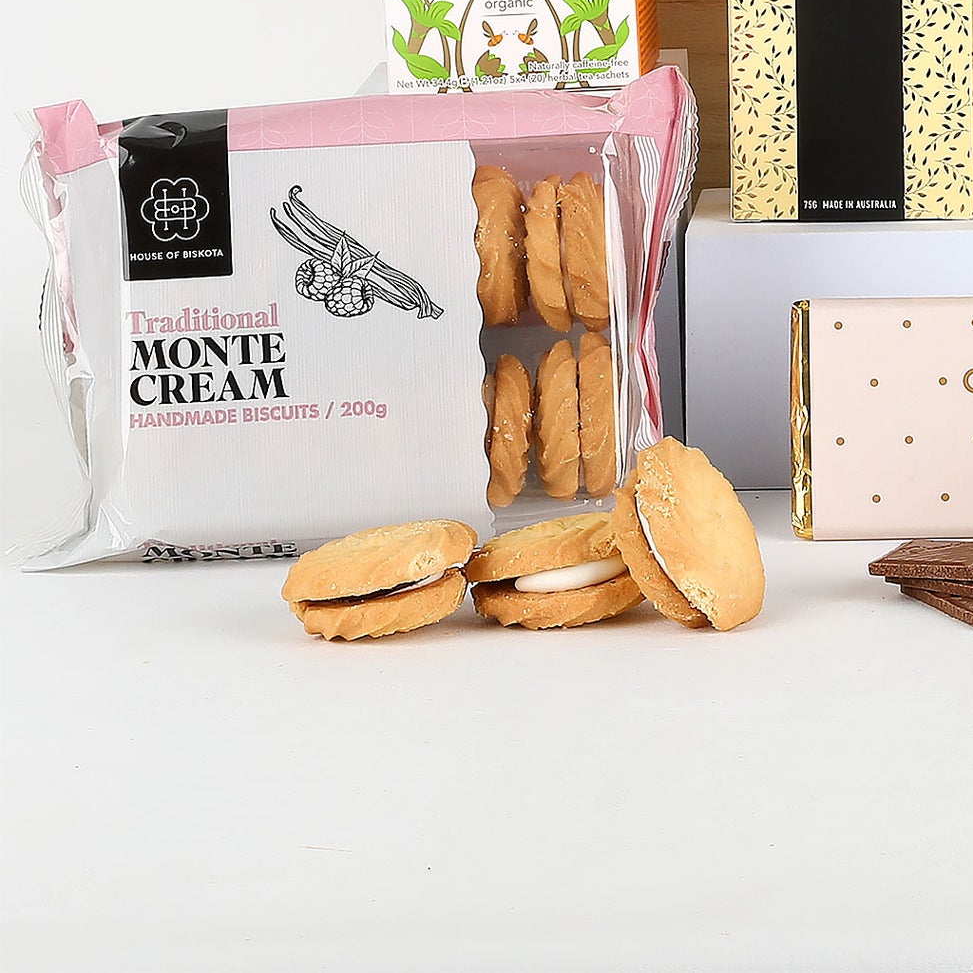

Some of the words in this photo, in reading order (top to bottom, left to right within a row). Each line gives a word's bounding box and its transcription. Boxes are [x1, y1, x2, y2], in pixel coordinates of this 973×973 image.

[529, 61, 570, 71] Naturally
[572, 58, 629, 68] caffeine-free
[396, 80, 414, 88] Net
[416, 79, 430, 88] Wt
[509, 75, 526, 83] 5x4
[528, 74, 546, 84] (20)
[547, 72, 577, 82] herbal
[578, 73, 594, 81] tea
[596, 70, 630, 80] sachets
[803, 200, 818, 209] 75G
[822, 200, 844, 209] MADE
[845, 200, 854, 209] IN
[855, 199, 897, 209] AUSTRALIA
[130, 250, 164, 262] HOUSE
[166, 250, 180, 260] OF
[183, 247, 224, 259] BISKOTA
[125, 303, 280, 335] Traditional
[130, 332, 286, 371] MONTE
[130, 367, 289, 406] CREAM
[130, 408, 237, 429] HANDMADE
[243, 403, 320, 423] BISCUITS
[325, 401, 334, 420] /
[340, 400, 388, 419] 200g
